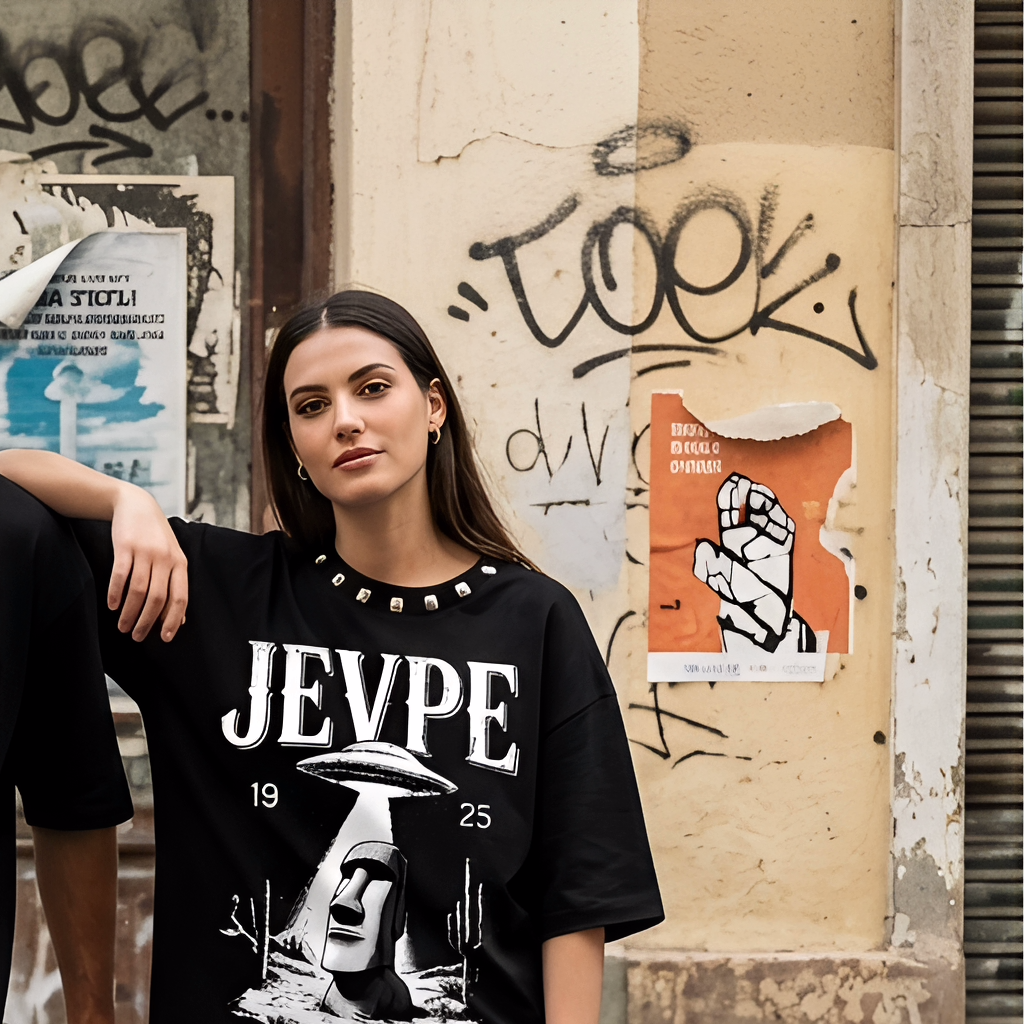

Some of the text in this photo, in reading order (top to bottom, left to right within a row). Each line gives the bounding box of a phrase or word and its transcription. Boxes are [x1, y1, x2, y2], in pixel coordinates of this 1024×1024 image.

[221, 640, 519, 776] JEVPE
[250, 781, 280, 809] 19
[459, 801, 492, 829] 25
